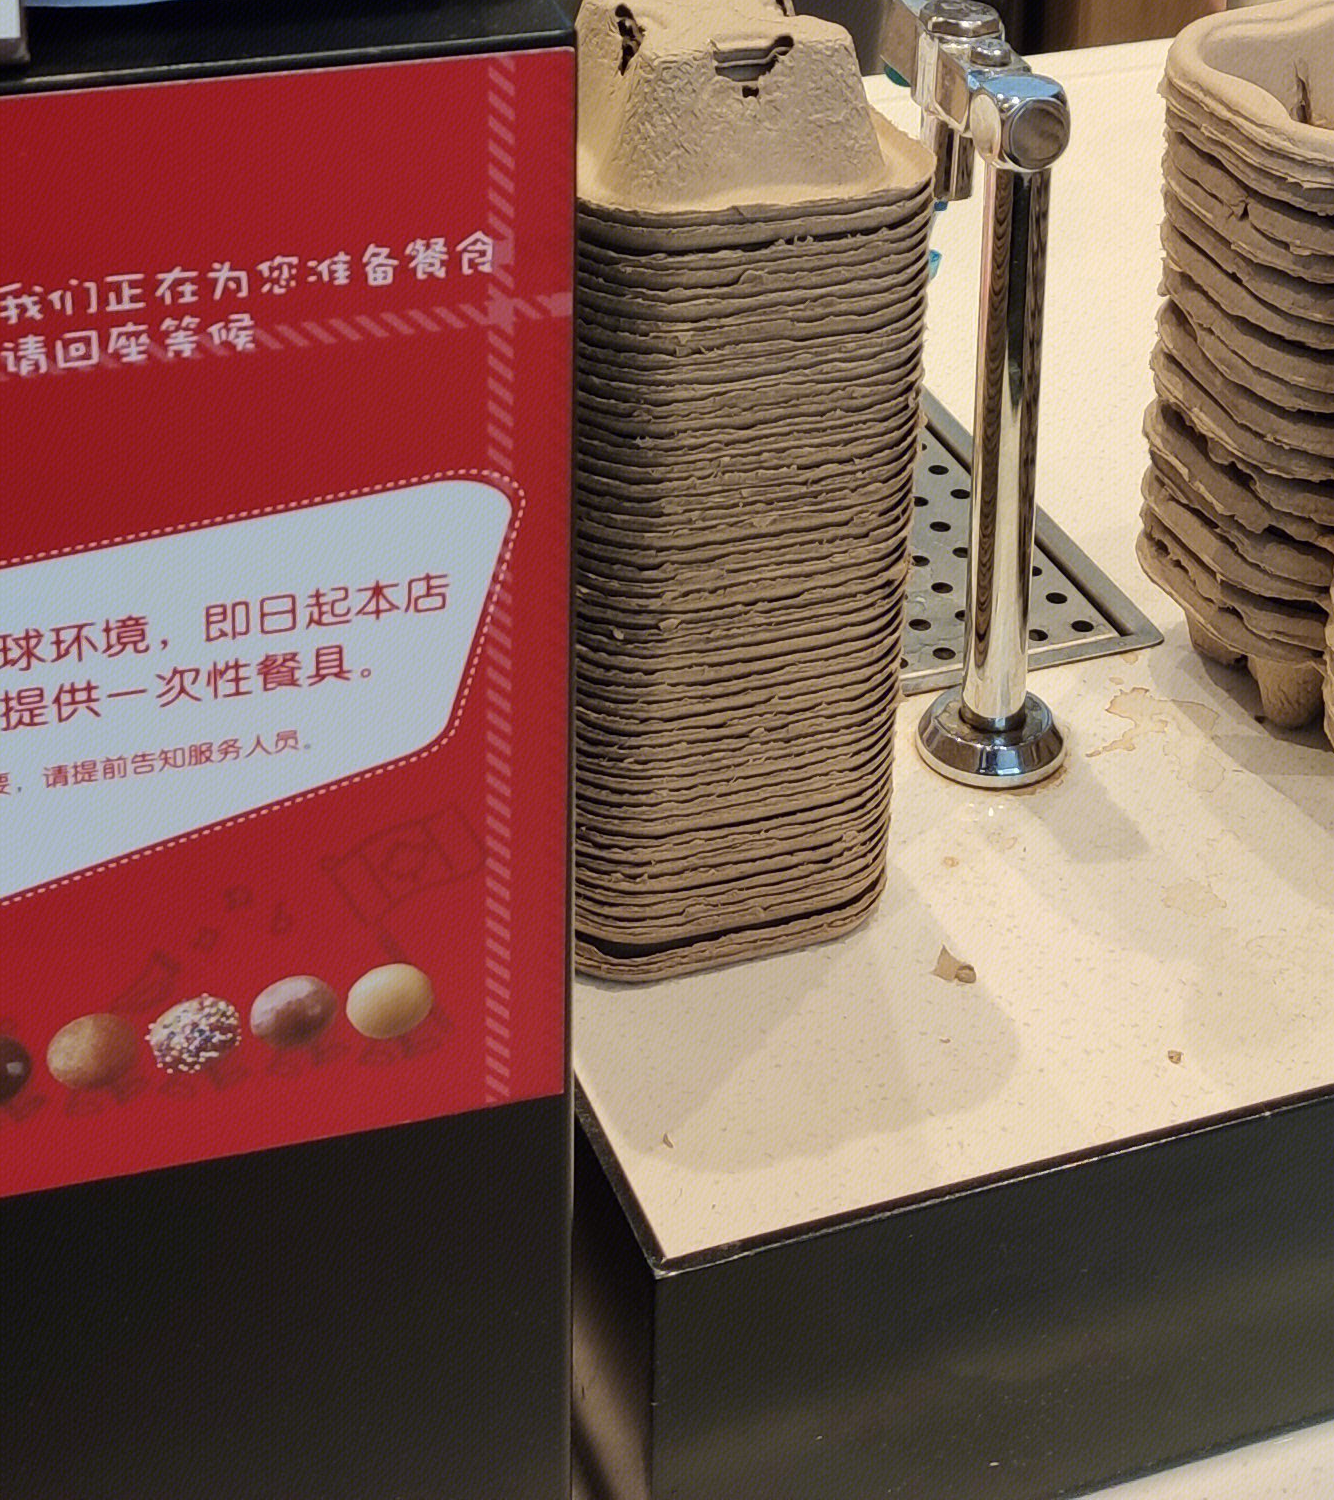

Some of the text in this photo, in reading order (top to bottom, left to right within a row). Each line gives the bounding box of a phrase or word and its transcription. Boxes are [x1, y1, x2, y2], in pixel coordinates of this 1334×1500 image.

[0, 312, 256, 377] 请回座等候
